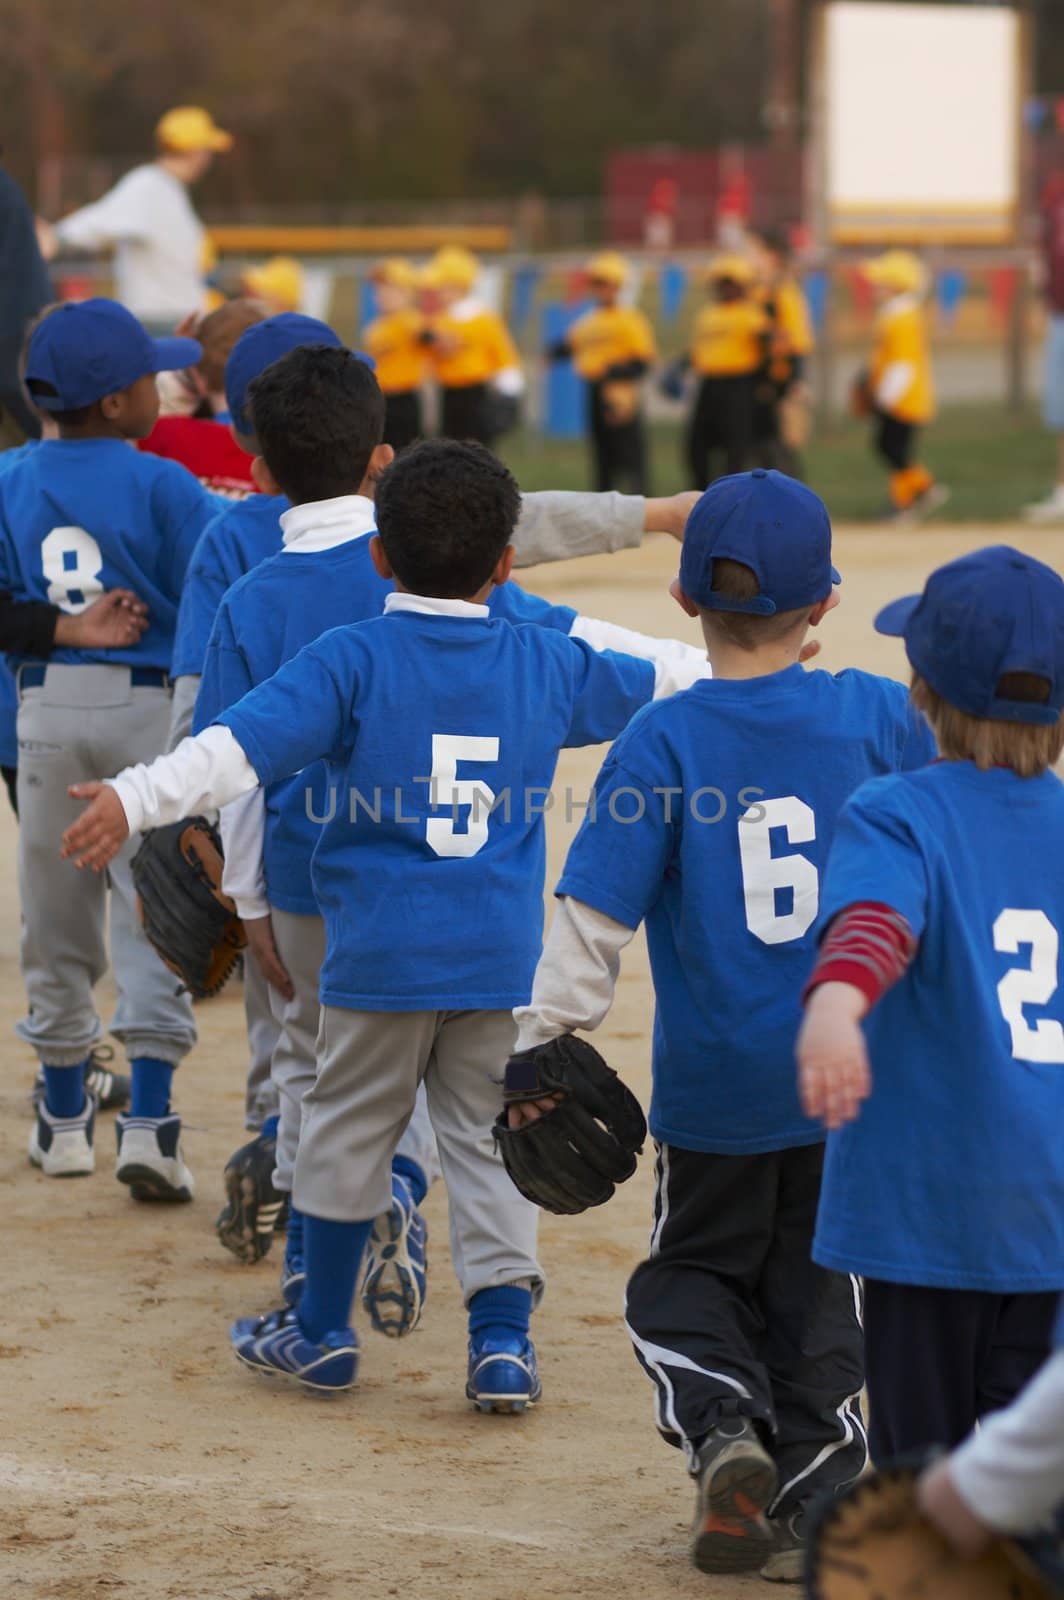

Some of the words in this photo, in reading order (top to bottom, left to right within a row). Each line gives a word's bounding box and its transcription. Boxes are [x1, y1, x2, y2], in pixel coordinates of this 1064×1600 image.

[41, 526, 103, 615] 8
[426, 733, 500, 858] 5
[738, 795, 819, 945] 6
[993, 908, 1064, 1063] 2
